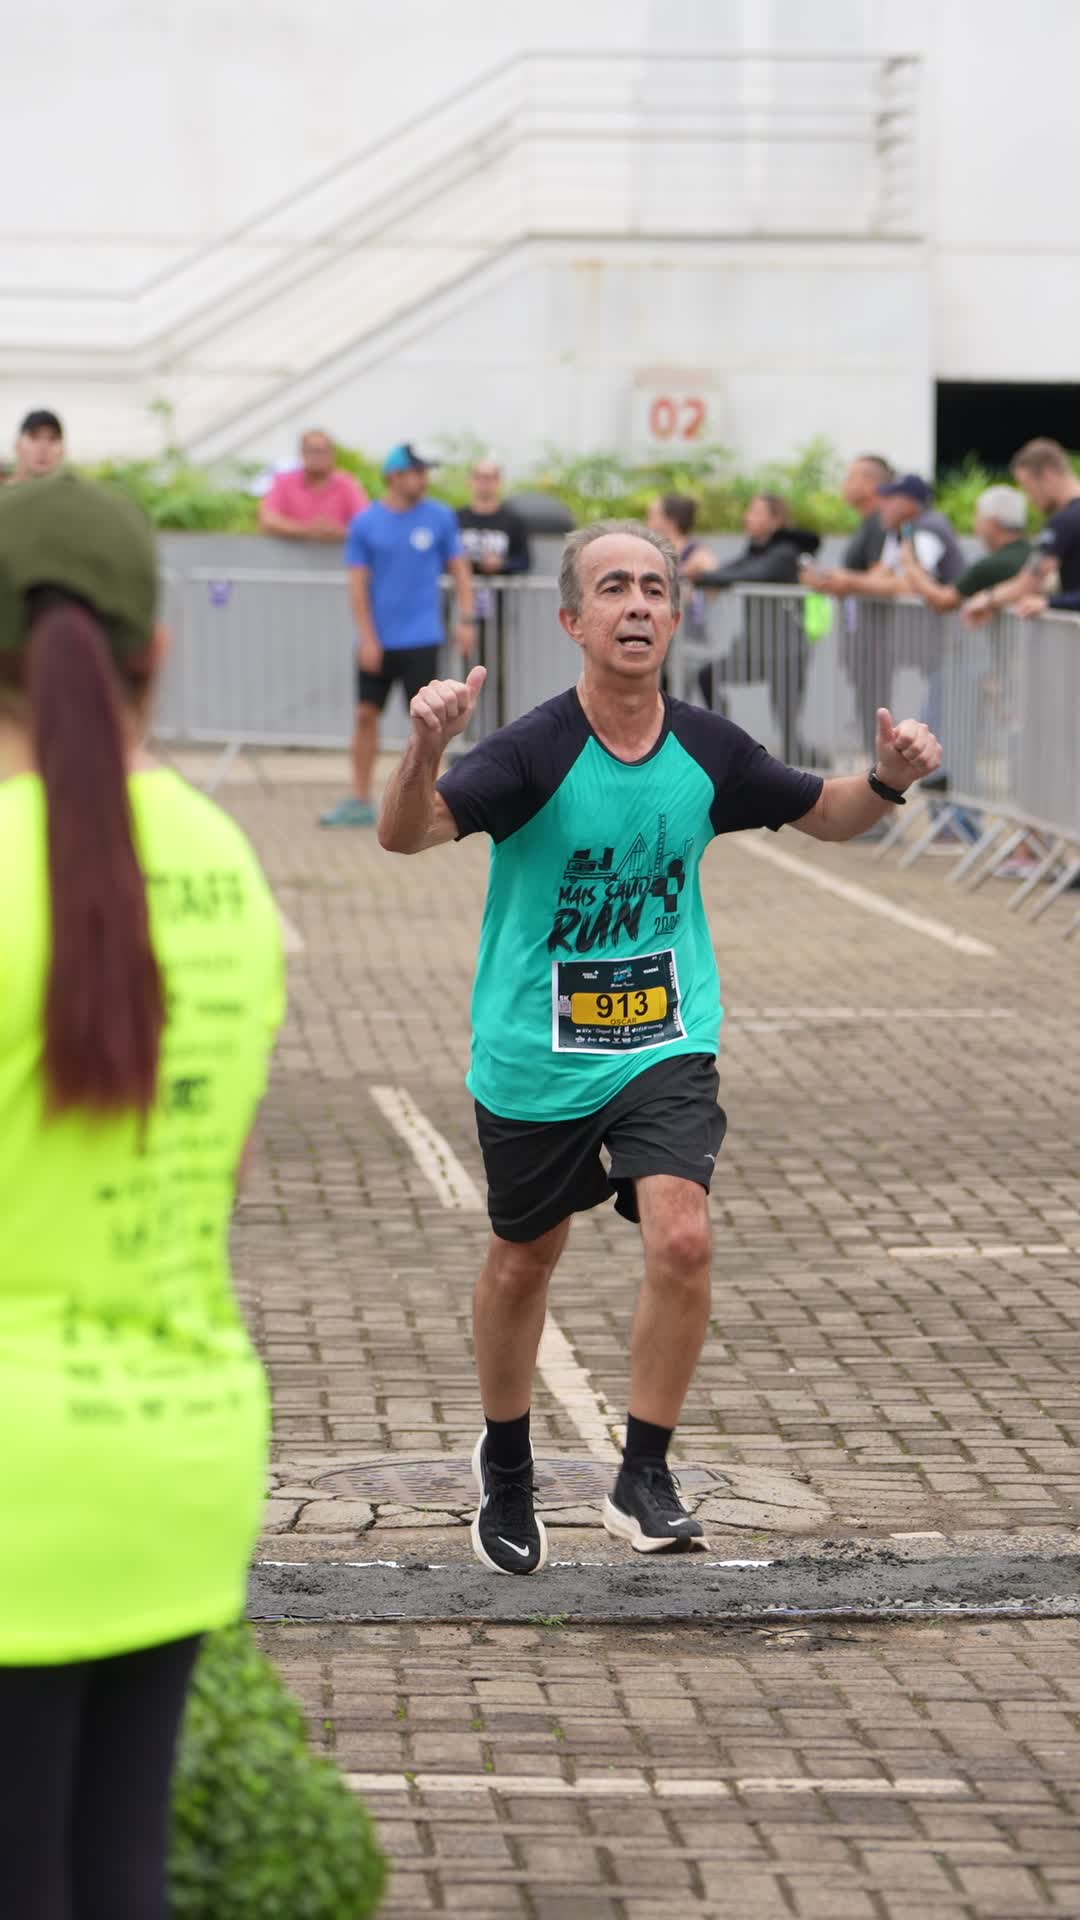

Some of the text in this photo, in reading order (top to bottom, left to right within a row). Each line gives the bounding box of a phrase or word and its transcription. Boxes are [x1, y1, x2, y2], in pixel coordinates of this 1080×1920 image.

[649, 396, 706, 441] 02
[558, 885, 596, 908] MAIS
[546, 895, 647, 953] RUN
[596, 991, 648, 1018] 913
[610, 1017, 637, 1025] OSCAR
